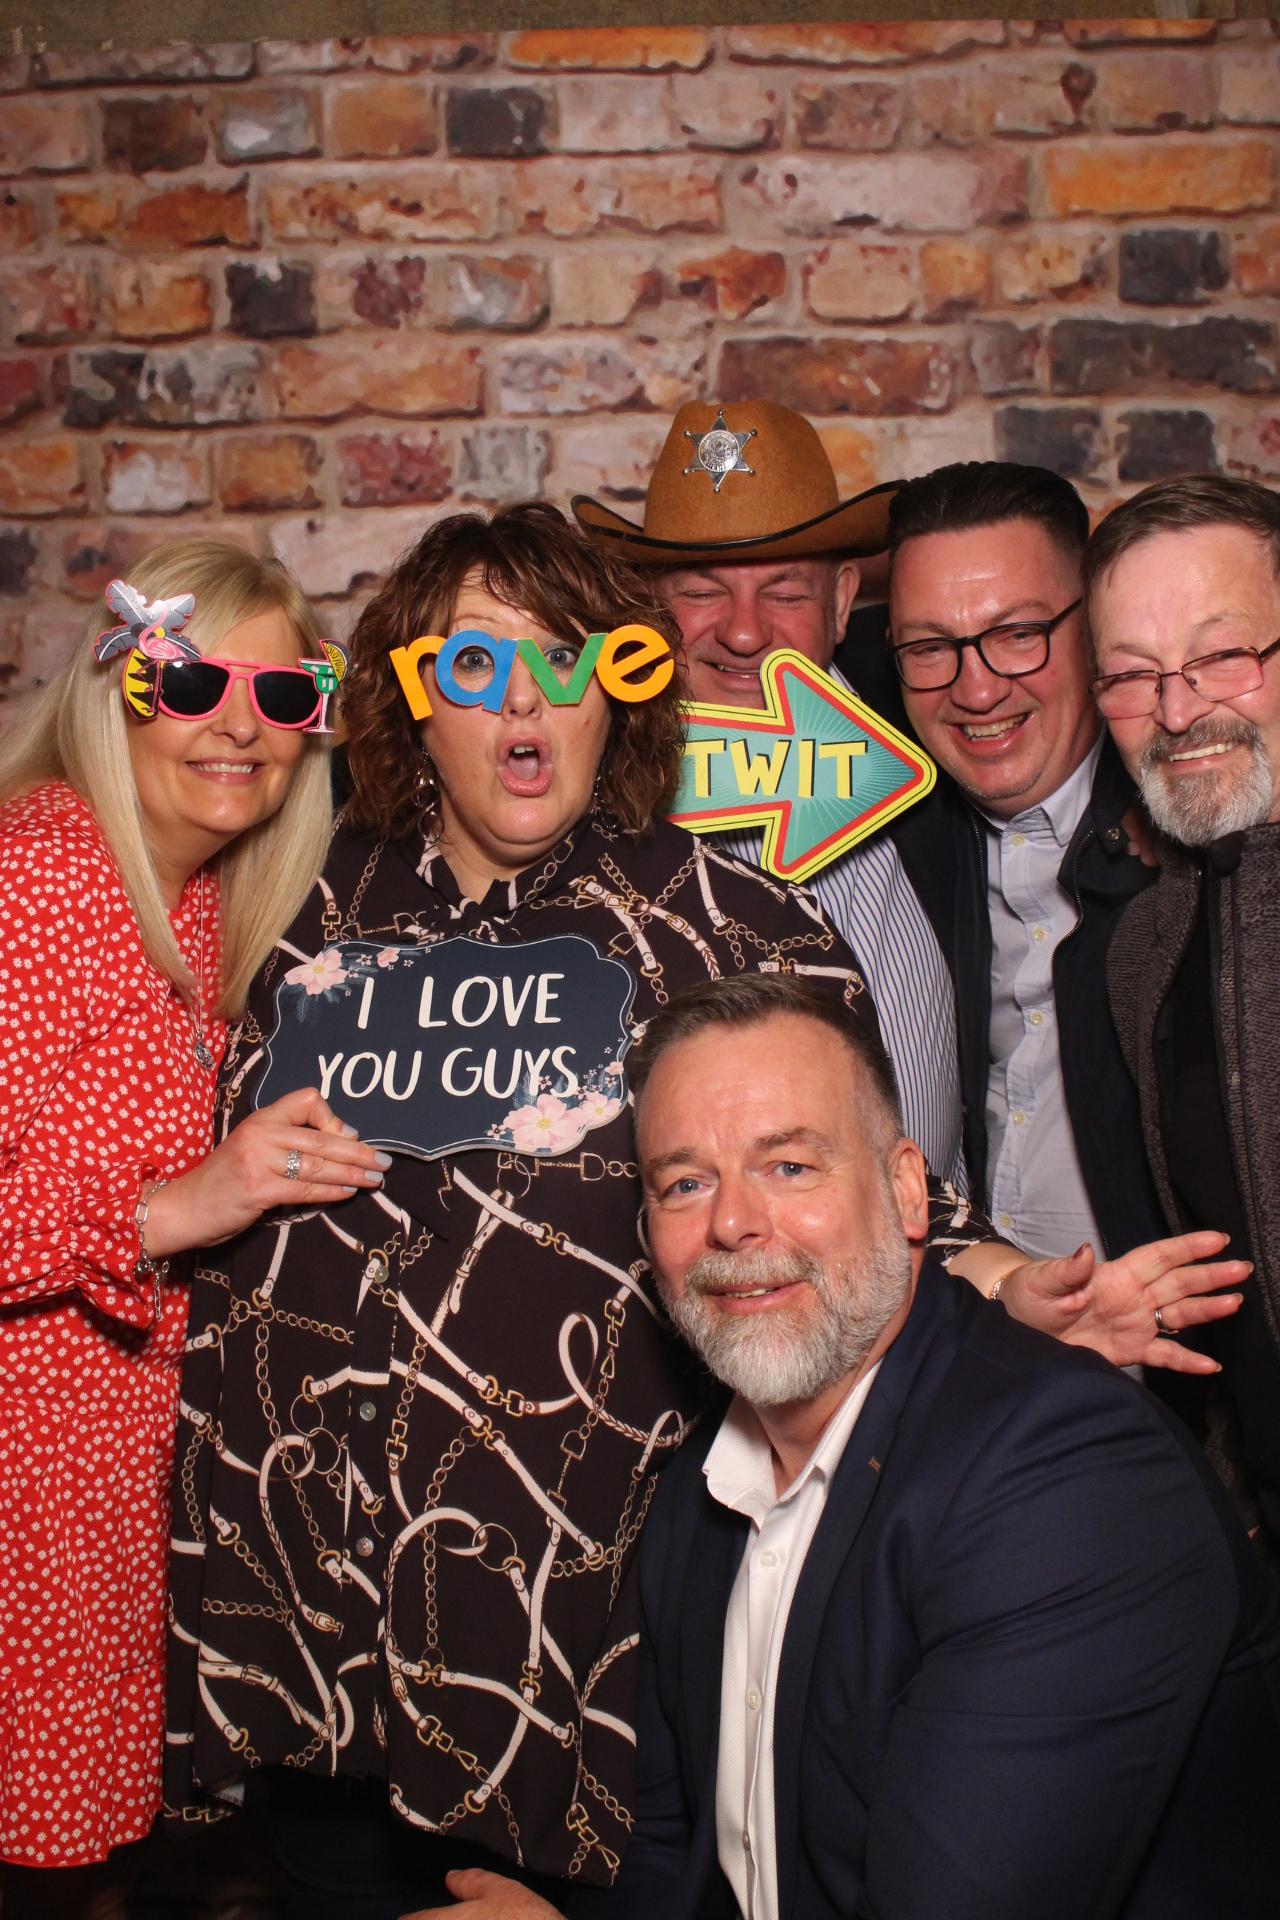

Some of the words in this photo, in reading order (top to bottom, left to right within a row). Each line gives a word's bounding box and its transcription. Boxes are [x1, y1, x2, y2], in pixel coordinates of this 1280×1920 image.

[389, 624, 674, 720] rave
[680, 738, 868, 799] TWIT
[358, 976, 375, 1029] I
[418, 973, 565, 1028] LOVE
[318, 1050, 422, 1100] YOU
[441, 1045, 578, 1098] GUYS
